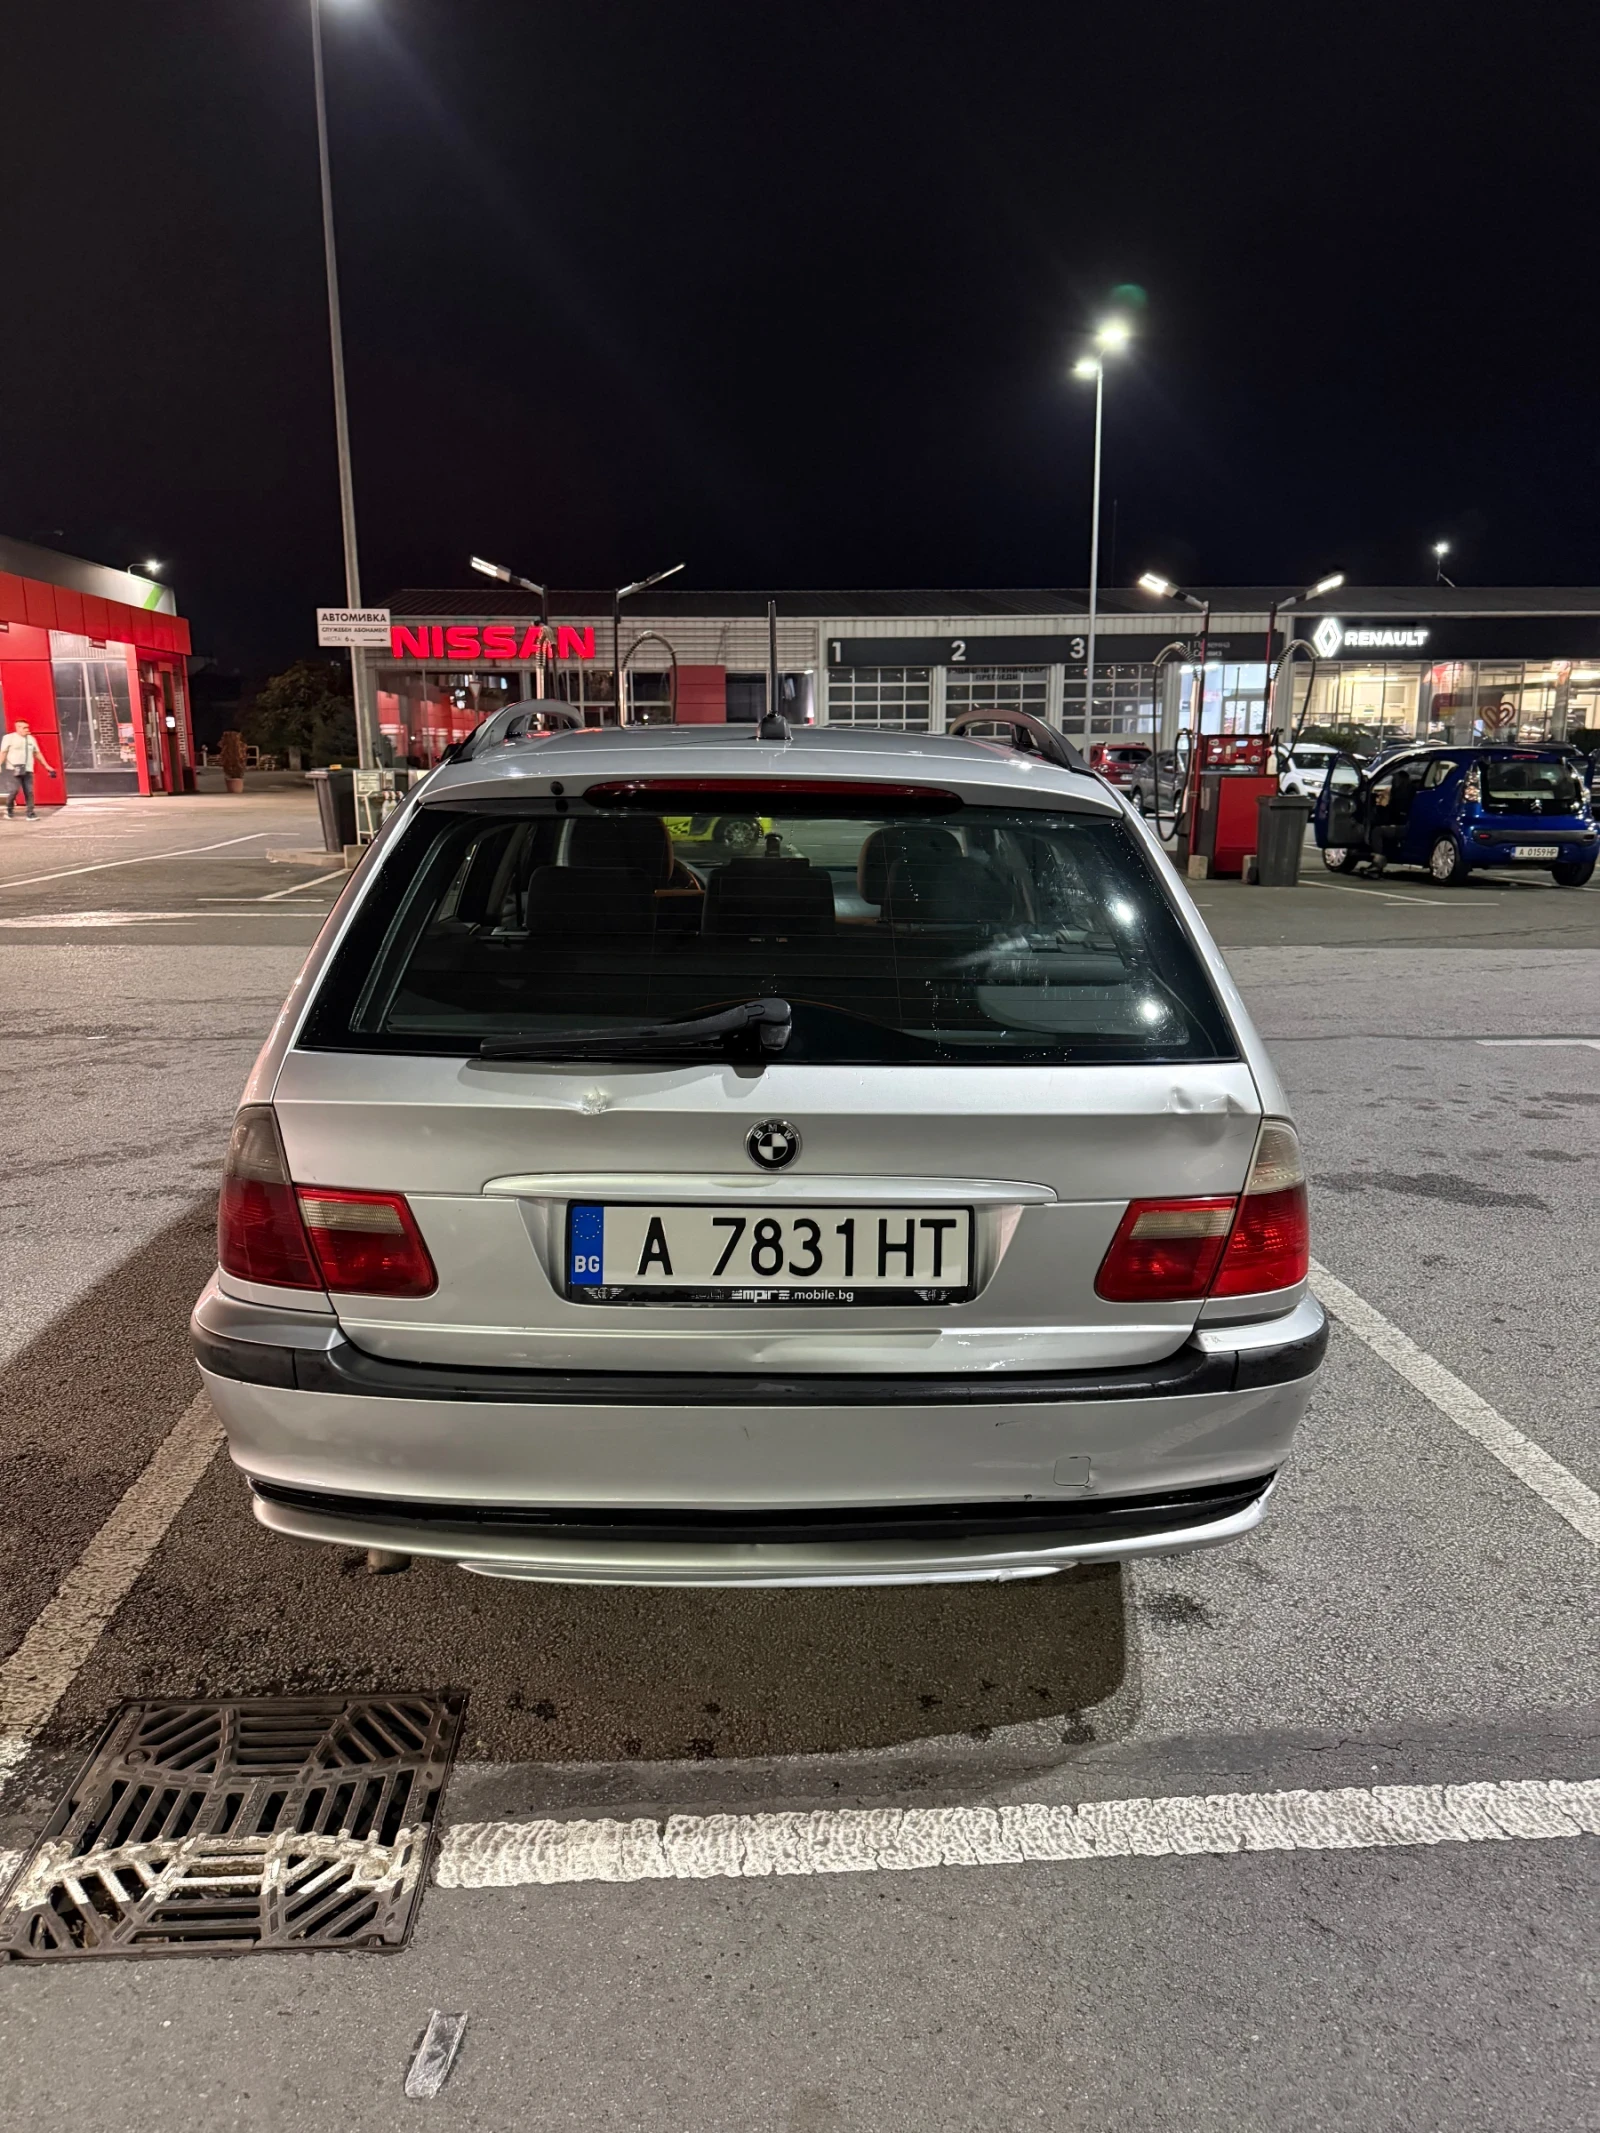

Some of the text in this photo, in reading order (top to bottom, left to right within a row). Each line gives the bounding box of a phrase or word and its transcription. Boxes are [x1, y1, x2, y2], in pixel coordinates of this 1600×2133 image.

[321, 613, 386, 622] АВТОМИВКА
[391, 625, 596, 660] NISSAN
[1070, 638, 1085, 658] 3
[1344, 630, 1428, 647] RENAULT
[832, 641, 842, 662] 1
[951, 640, 966, 661] 2
[753, 1124, 794, 1140] BMW
[637, 1216, 674, 1276] A
[574, 1255, 600, 1273] BG
